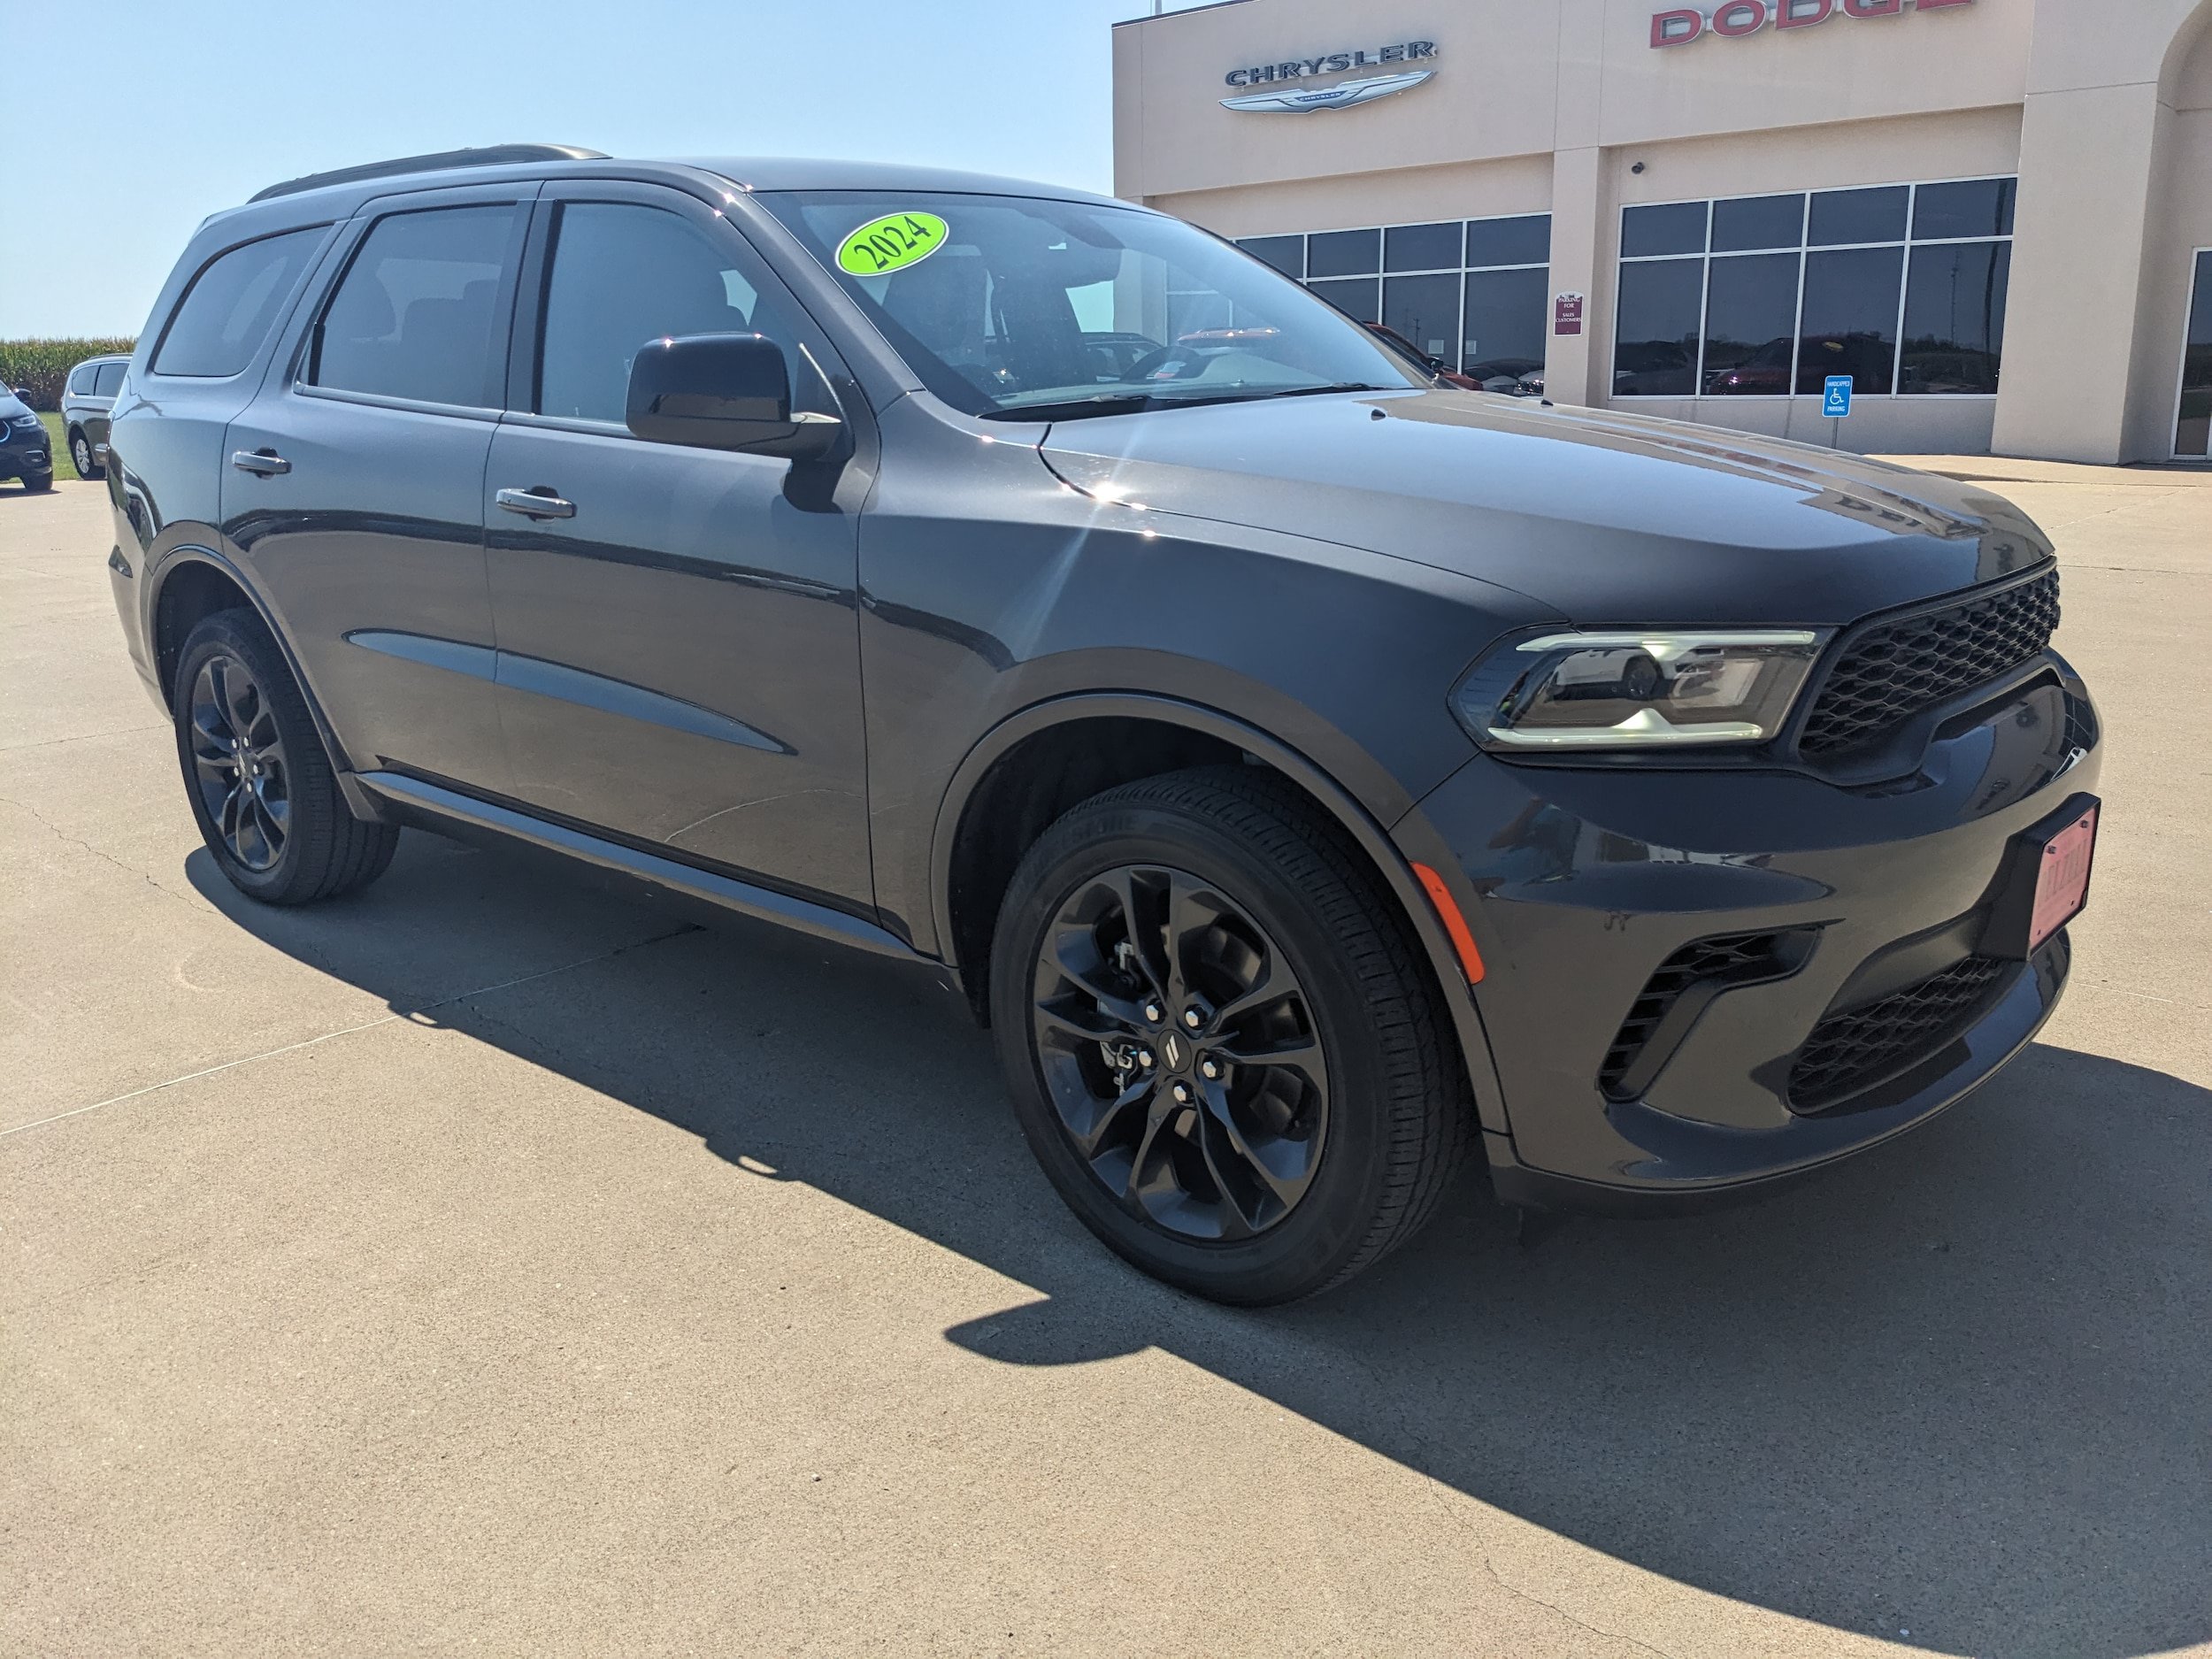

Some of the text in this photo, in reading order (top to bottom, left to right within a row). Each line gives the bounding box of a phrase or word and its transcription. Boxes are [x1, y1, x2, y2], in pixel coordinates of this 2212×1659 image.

[1650, 0, 1973, 49] DOD
[1225, 41, 1434, 87] CHRYSLER
[1299, 92, 1340, 102] CHRYSLER
[854, 216, 932, 270] 2024
